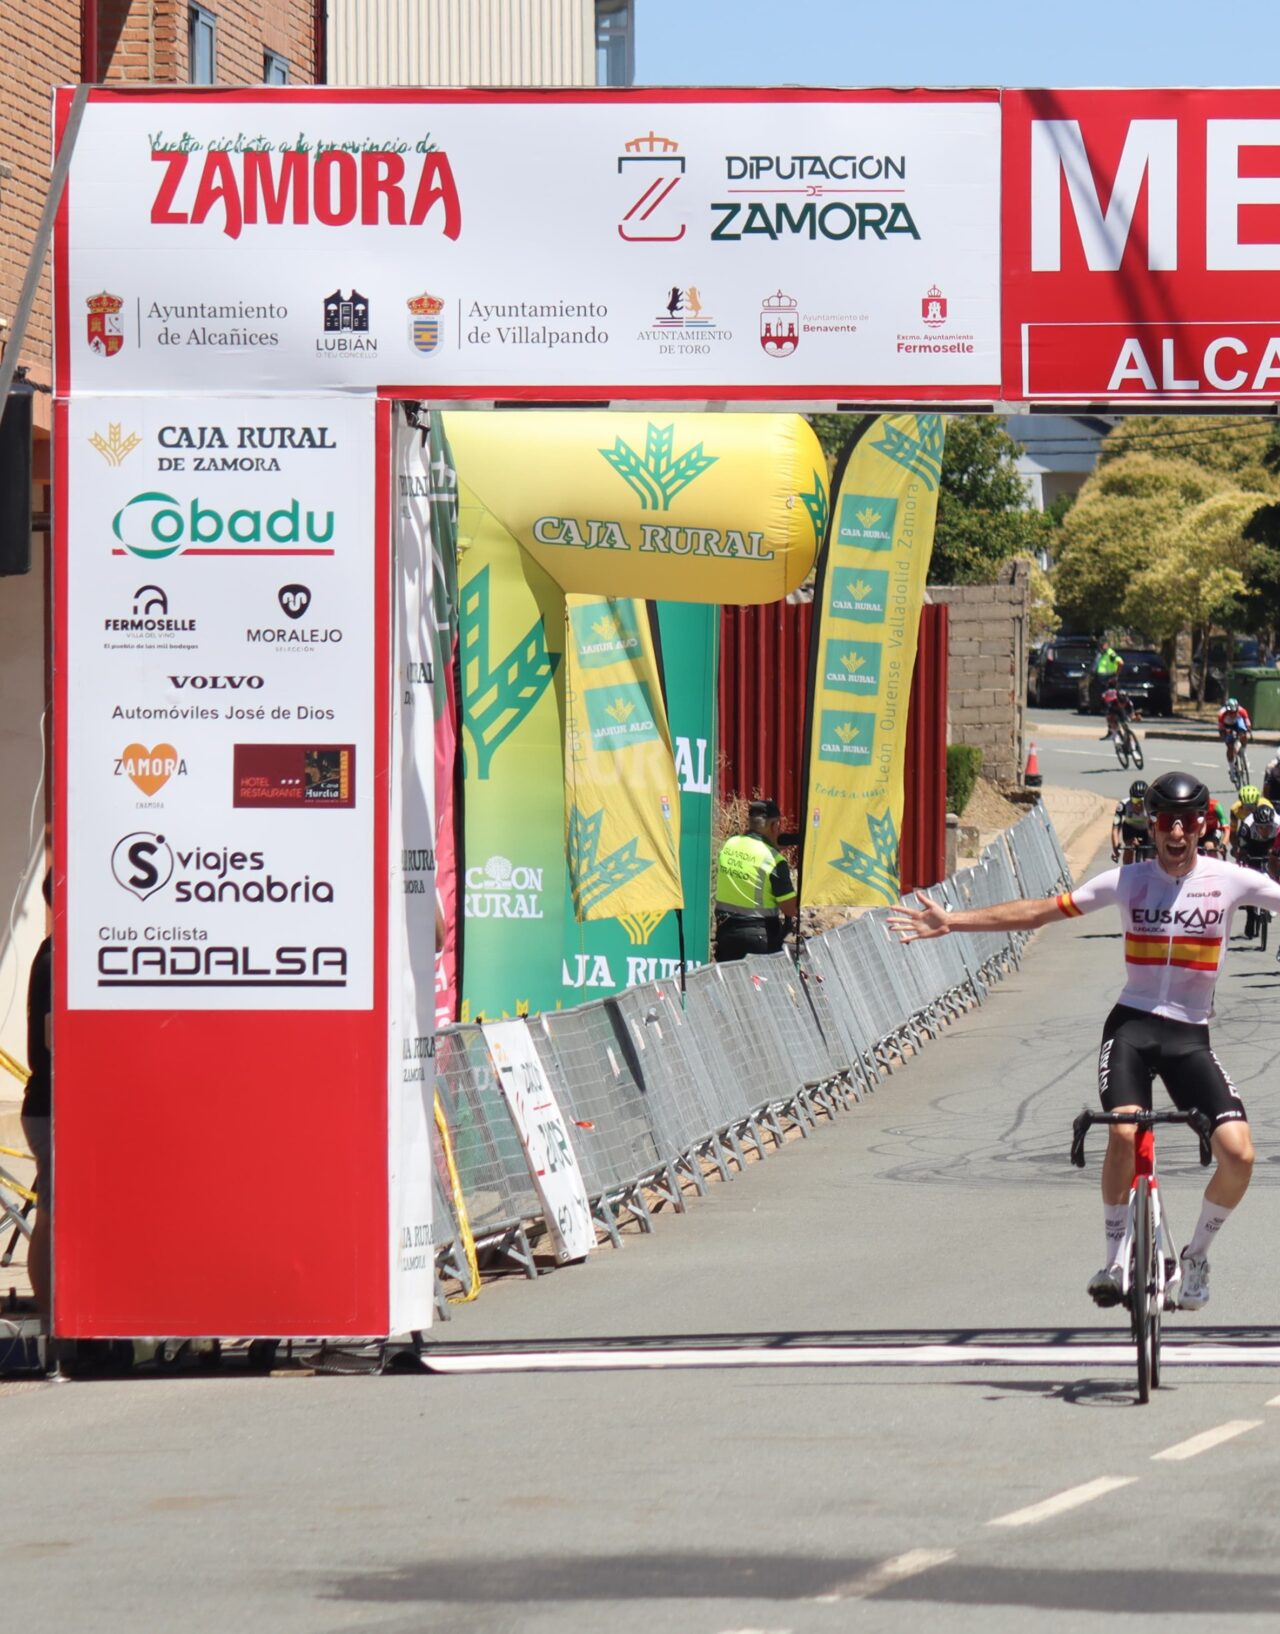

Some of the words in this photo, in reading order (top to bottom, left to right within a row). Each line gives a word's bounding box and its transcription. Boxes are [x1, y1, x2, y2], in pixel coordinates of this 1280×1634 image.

[150, 150, 462, 241] ZAMORA
[710, 202, 922, 241] ZAMORA
[147, 301, 288, 323] Ayuntamiento
[468, 300, 608, 325] Ayuntamiento
[803, 314, 858, 322] Ayuntamiento
[157, 327, 182, 345] de
[186, 327, 279, 346] Alcañices
[636, 330, 733, 341] AYUNTAMIENTO
[803, 325, 857, 333] Benavente
[316, 335, 377, 351] LUBIÁN
[467, 326, 491, 344] de
[496, 326, 609, 348] Villalpando
[923, 334, 974, 342] Ayuntamiento
[659, 344, 676, 354] DE
[677, 344, 711, 354] TORO
[897, 342, 974, 354] Fermoselle
[157, 426, 229, 450] CAJA
[237, 426, 337, 449] RURAL
[158, 458, 185, 471] DE
[193, 457, 281, 471] ZAMORA
[897, 483, 919, 549] Zamora
[111, 491, 334, 560] Cobadu
[532, 516, 630, 551] CAJA
[641, 524, 775, 561] RURAL
[841, 527, 862, 538] CAJA
[863, 529, 891, 540] RURAL
[832, 600, 853, 610] CAJA
[854, 602, 883, 612] RURAL
[888, 560, 911, 648] Valladolid
[105, 619, 196, 631] FERMOSELLE
[246, 629, 343, 643] MORALEJO
[167, 675, 265, 689] VOLVO
[826, 673, 847, 682] CAJA
[848, 674, 876, 684] RURAL
[879, 664, 900, 731] Ourense
[112, 705, 219, 720] Automóviles
[225, 705, 265, 720] José
[271, 705, 291, 720] de
[297, 705, 335, 720] Dios
[821, 743, 841, 752] CAJA
[842, 744, 870, 755] RURAL
[113, 757, 188, 776] ZAMORA
[876, 743, 892, 784] León
[241, 777, 270, 787] HOTEL
[240, 788, 302, 798] RESTAURANTE
[176, 847, 265, 879] viajes
[175, 875, 334, 903] sanabria
[99, 926, 138, 941] Club
[144, 926, 208, 941] Ciclista
[97, 946, 347, 975] CADALSA
